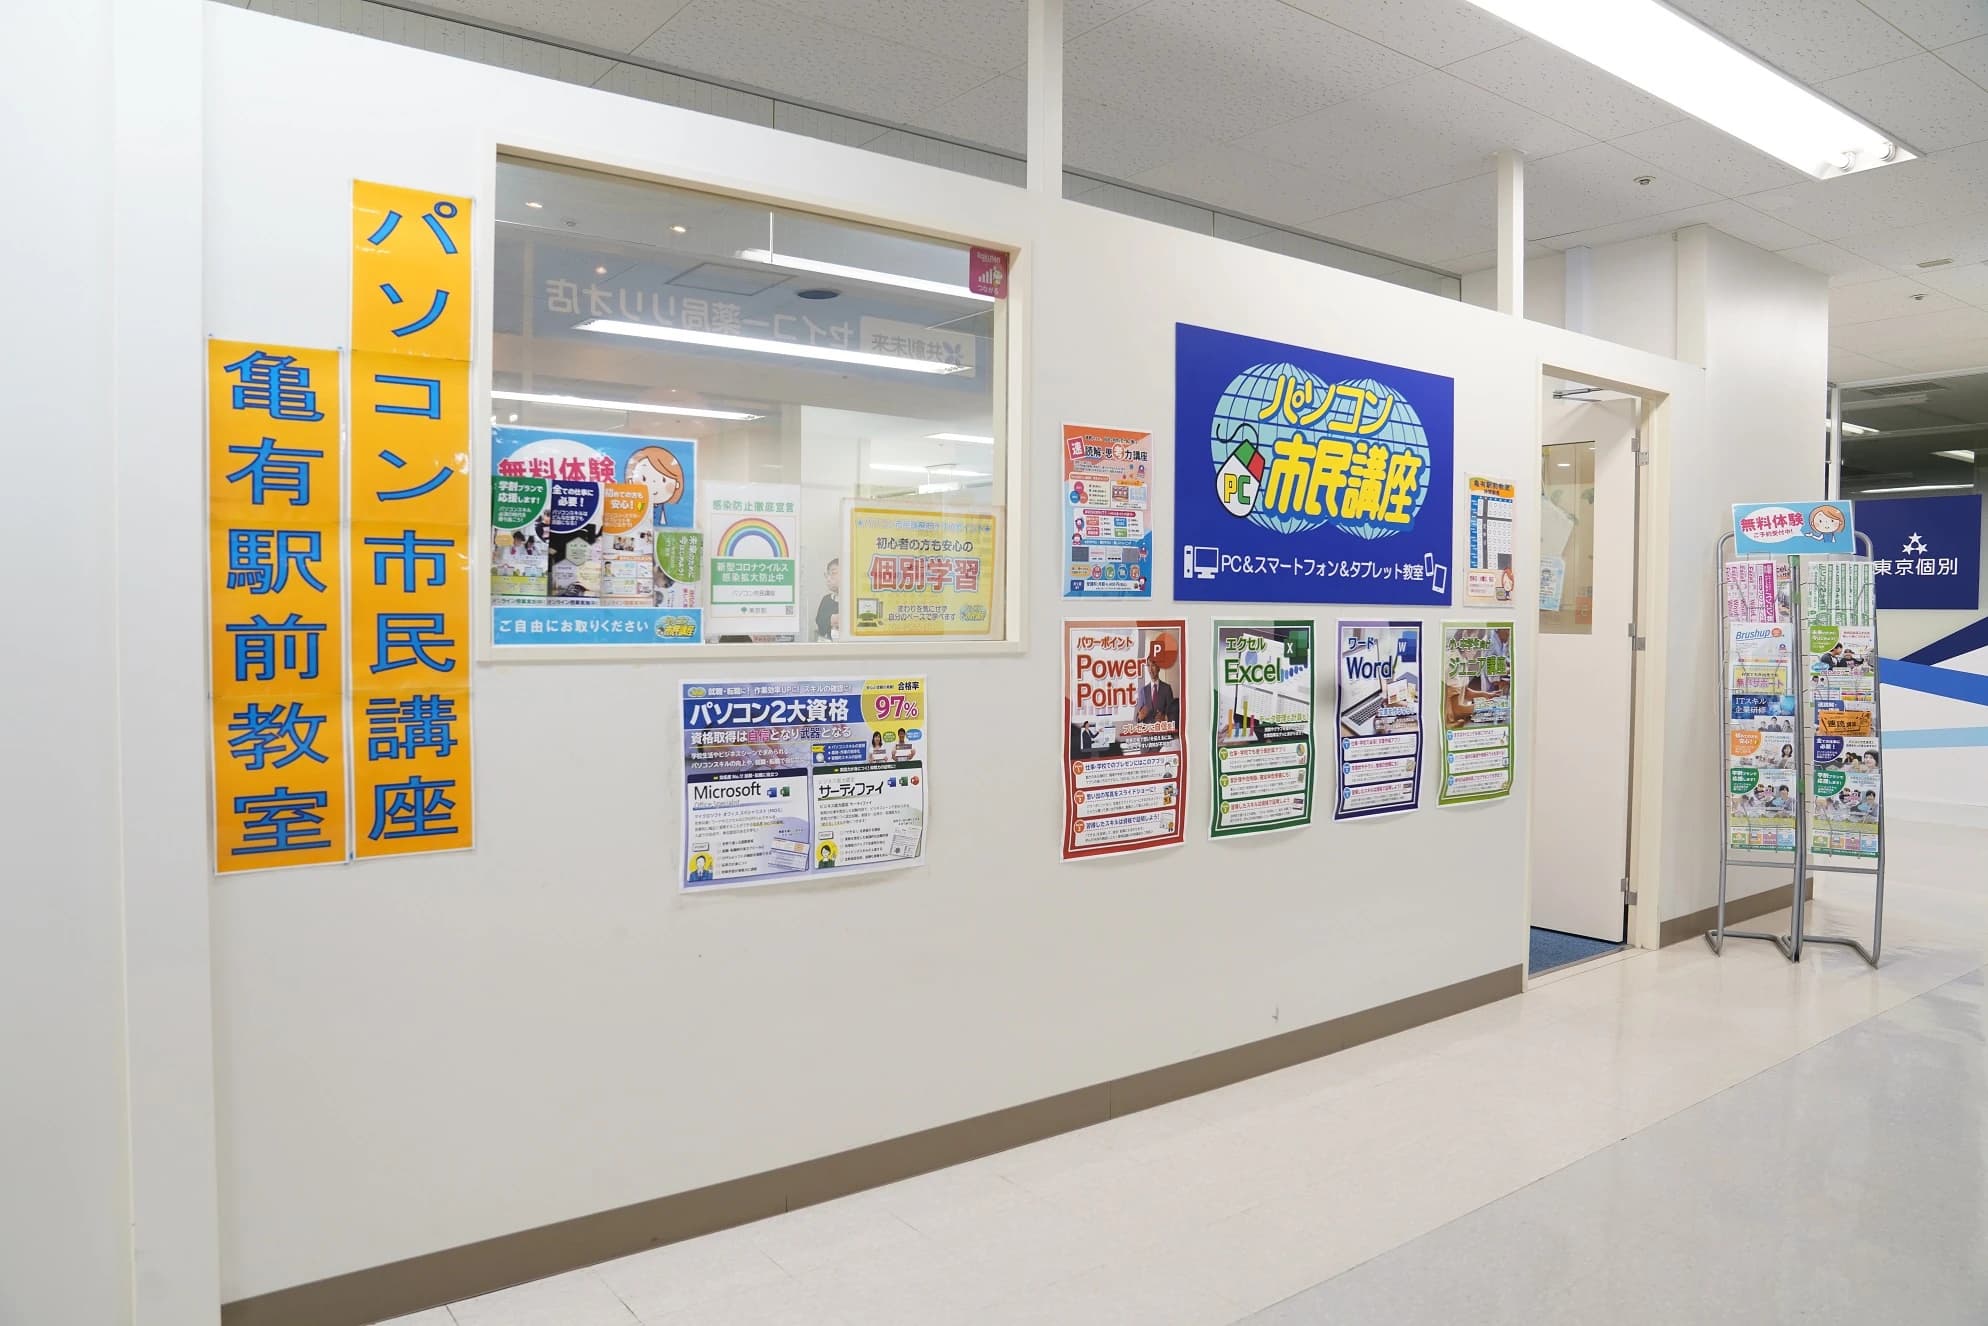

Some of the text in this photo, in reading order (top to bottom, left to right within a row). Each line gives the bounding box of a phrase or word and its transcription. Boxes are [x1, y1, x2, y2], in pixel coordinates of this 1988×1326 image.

[1259, 374, 1394, 434] パソコン
[498, 456, 617, 484] 無料体験
[1264, 433, 1423, 524] 市民講座
[552, 485, 595, 497] 全ての仕事に
[1223, 473, 1251, 505] PC
[713, 500, 794, 513] 感染防止徹底宣言
[364, 201, 459, 840] パソコン市民講座
[1740, 512, 1804, 532] 無料体験
[876, 537, 974, 552] 初心者の方も安心の
[717, 562, 789, 572] 新型コロナウイルス
[869, 555, 980, 591] 個別学習
[1221, 554, 1424, 581] PC&スマートフォン&タブレット教室
[1874, 558, 1958, 576] 東京個別
[722, 573, 785, 583] 感染拡大防止中
[224, 351, 331, 856] 亀有駅前教室
[898, 605, 948, 613] まわりを気にせず
[888, 612, 956, 621] 自分のペースで学べます
[499, 619, 649, 633] ご自由にお取りください
[1735, 628, 1771, 640] Brushup
[1077, 636, 1133, 649] パワーポイント
[1153, 644, 1162, 657] P
[1225, 637, 1266, 651] エクセル
[1287, 642, 1294, 654] X
[1348, 637, 1375, 650] ワード
[1398, 641, 1407, 653] W
[1076, 654, 1147, 679] Power
[1224, 657, 1280, 684] Excel
[1346, 655, 1392, 679] Word
[897, 681, 920, 691] 合格率
[1076, 682, 1137, 708] Point
[690, 698, 849, 726] パソコン2大資格
[874, 695, 919, 720] 97%
[691, 726, 852, 745] 資格取得は自信となり武器となる
[694, 781, 761, 800] Microsoft
[818, 781, 884, 799] サーティファイ
